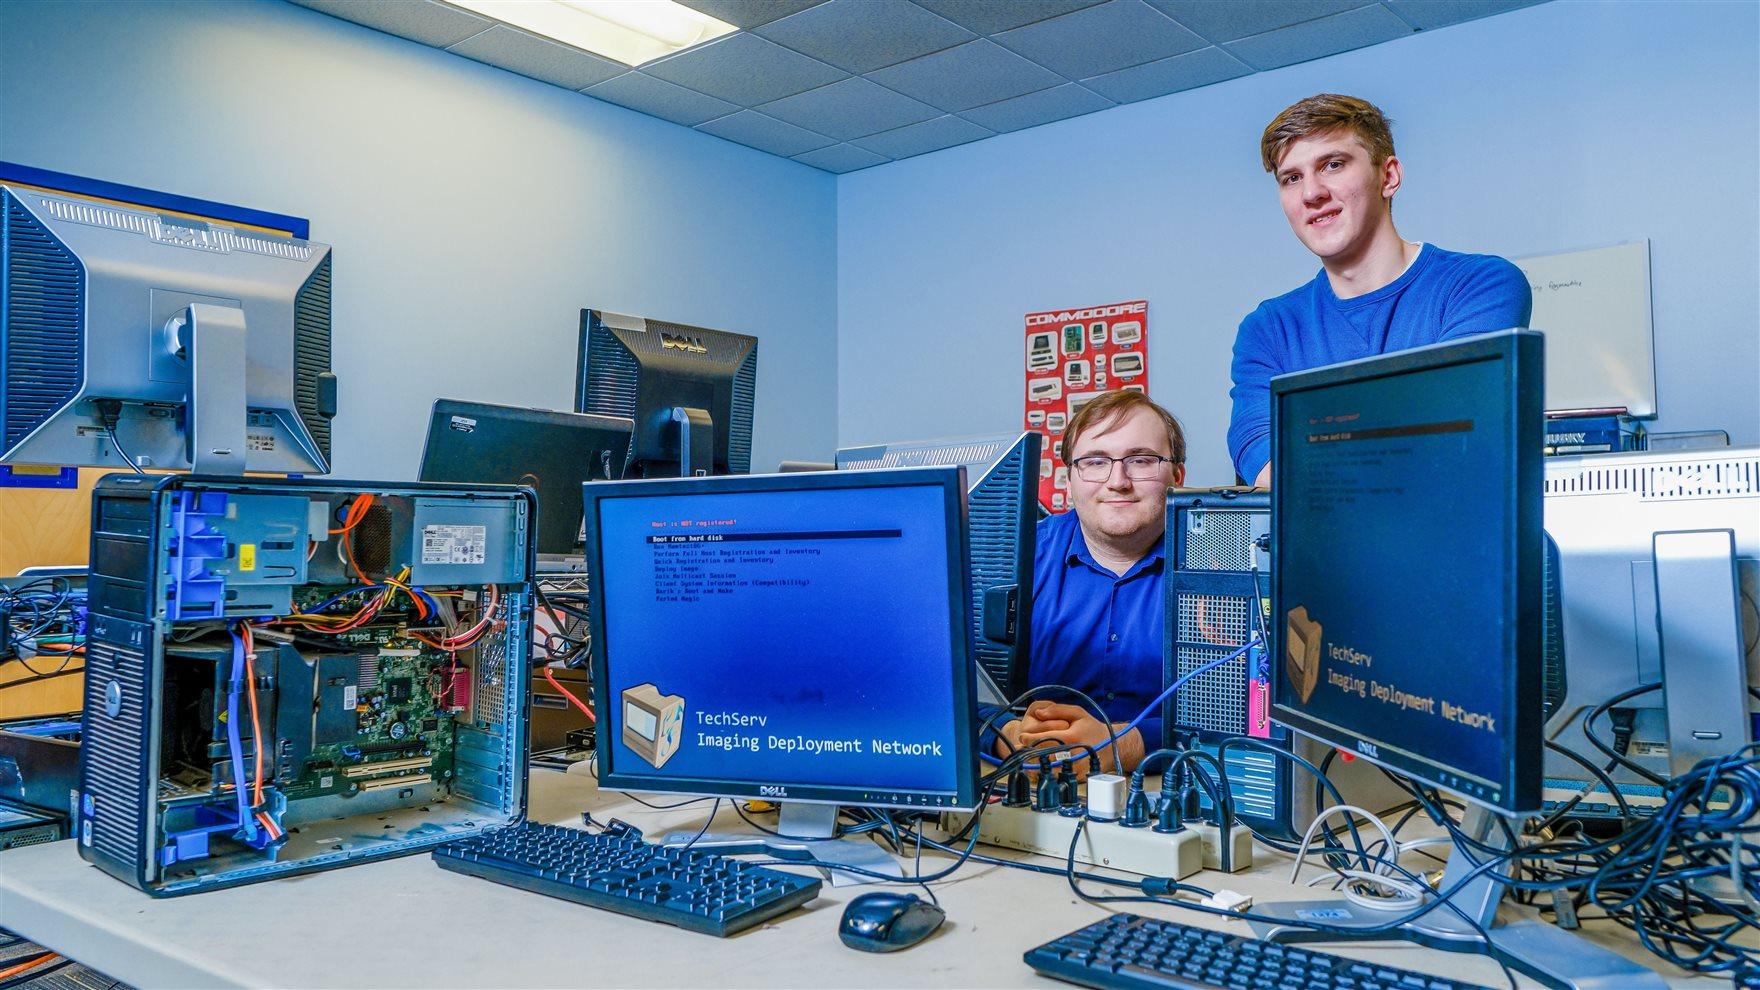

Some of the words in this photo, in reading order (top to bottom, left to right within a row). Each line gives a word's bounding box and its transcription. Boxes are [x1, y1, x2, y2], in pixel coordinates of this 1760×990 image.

[1026, 303, 1147, 326] COMMODORE
[660, 332, 708, 354] DELL
[1328, 643, 1372, 668] TechServ
[1328, 668, 1366, 698] Imaging
[1371, 680, 1435, 715] Deployment
[1441, 701, 1496, 733] Network
[696, 711, 767, 727] TechServ
[698, 733, 760, 751] Imaging
[768, 735, 862, 754] Deployment
[872, 740, 942, 756] Network
[1357, 740, 1379, 758] DELL
[760, 785, 788, 798] DELL
